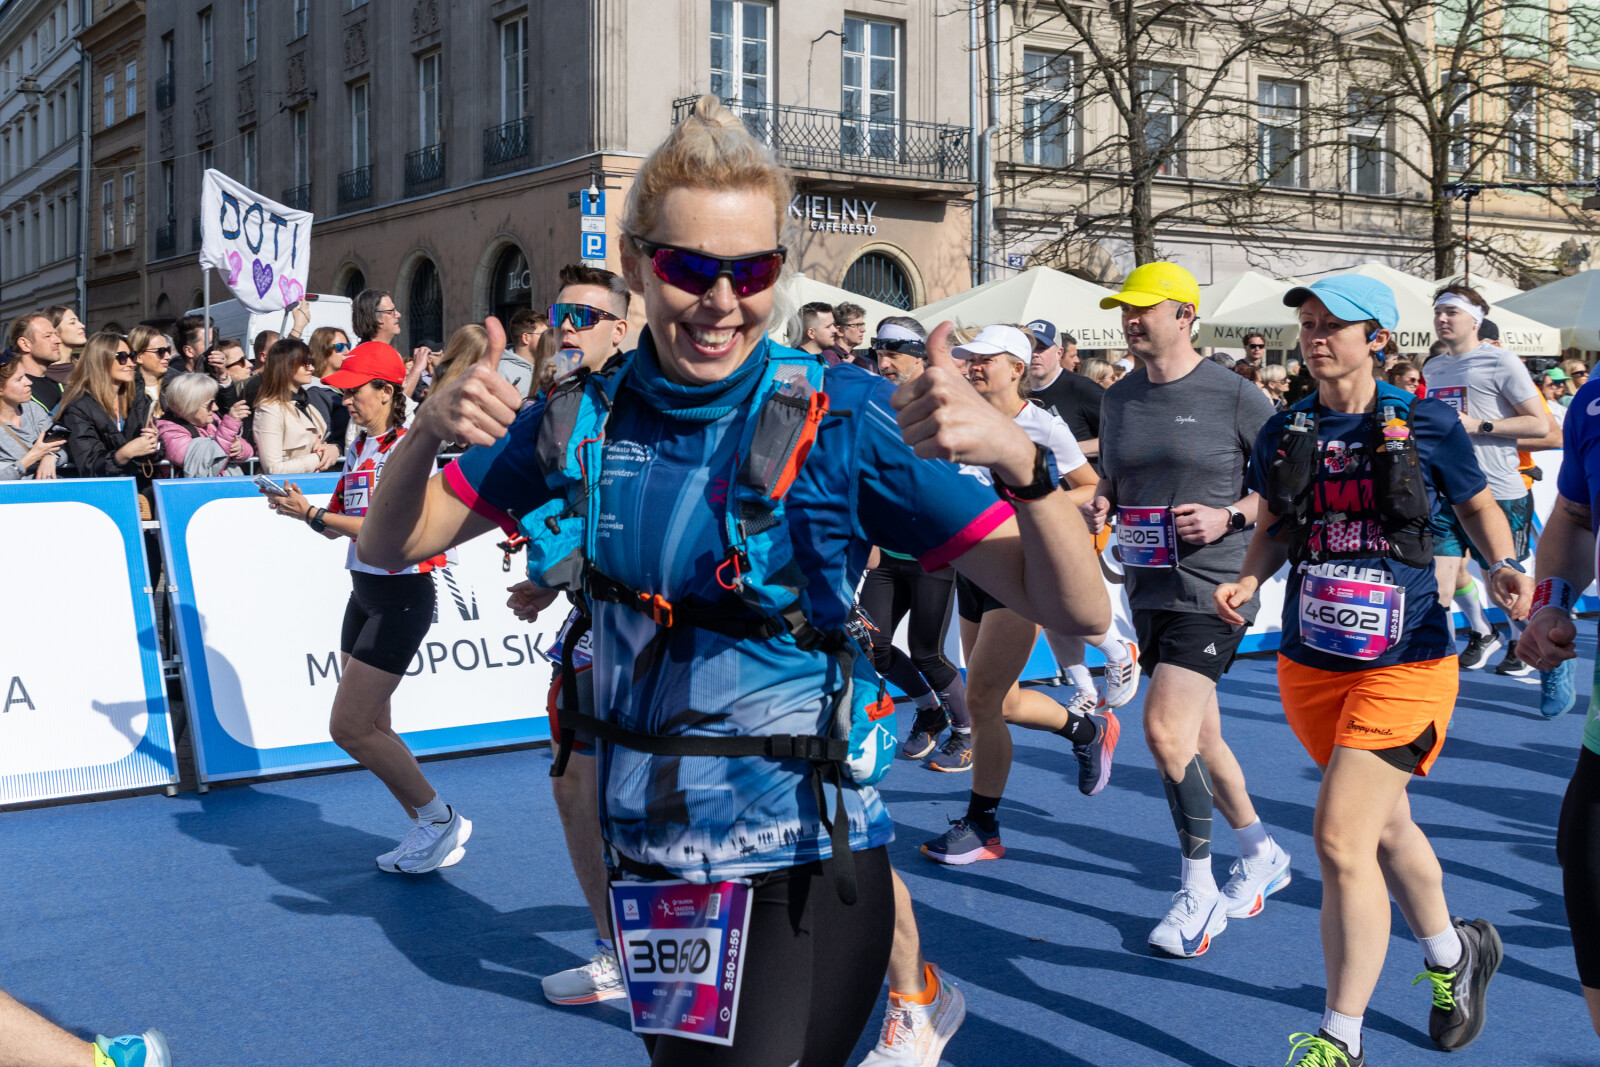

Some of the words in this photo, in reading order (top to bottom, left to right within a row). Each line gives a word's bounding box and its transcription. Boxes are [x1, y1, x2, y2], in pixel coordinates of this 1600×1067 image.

[787, 194, 877, 223] KIELNY
[811, 221, 838, 231] CAFE
[841, 223, 876, 234] RESTO
[587, 235, 602, 255] P
[1500, 331, 1543, 345] IELNY
[1119, 529, 1160, 545] 4205
[1305, 602, 1380, 631] 4602
[628, 937, 712, 976] 3860
[723, 928, 741, 992] 3:50-3:59
